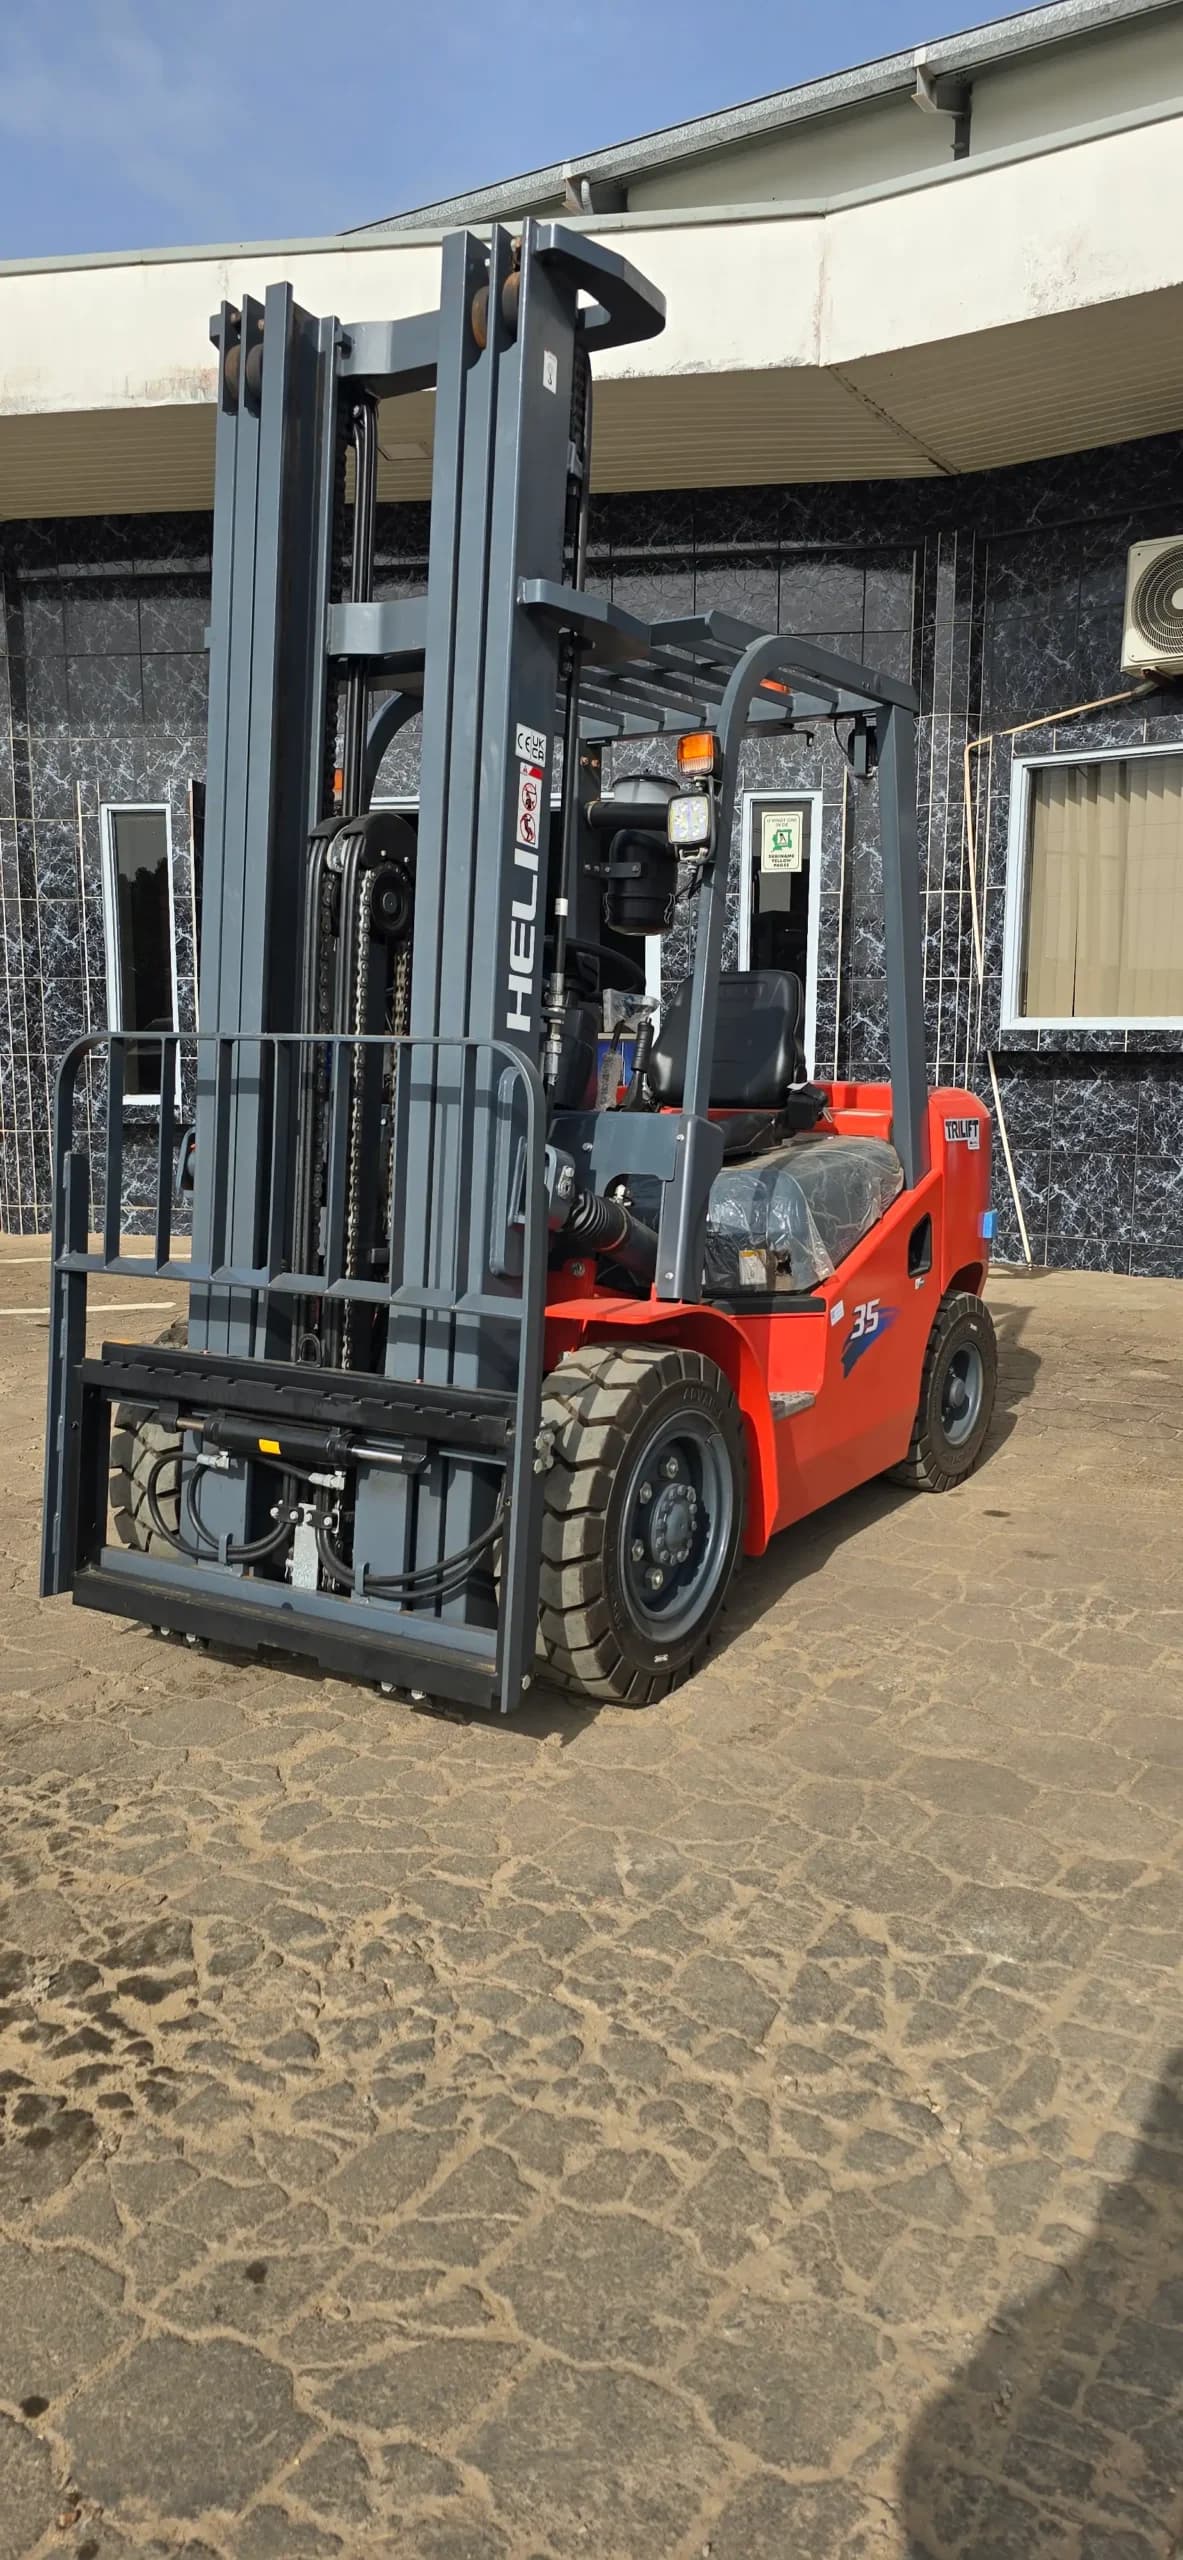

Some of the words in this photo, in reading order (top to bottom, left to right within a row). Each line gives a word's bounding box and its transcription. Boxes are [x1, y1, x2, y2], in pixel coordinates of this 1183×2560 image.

[531, 747, 545, 761] CA
[532, 735, 545, 751] UK
[506, 848, 539, 1032] HELI
[850, 1298, 880, 1340] 35
